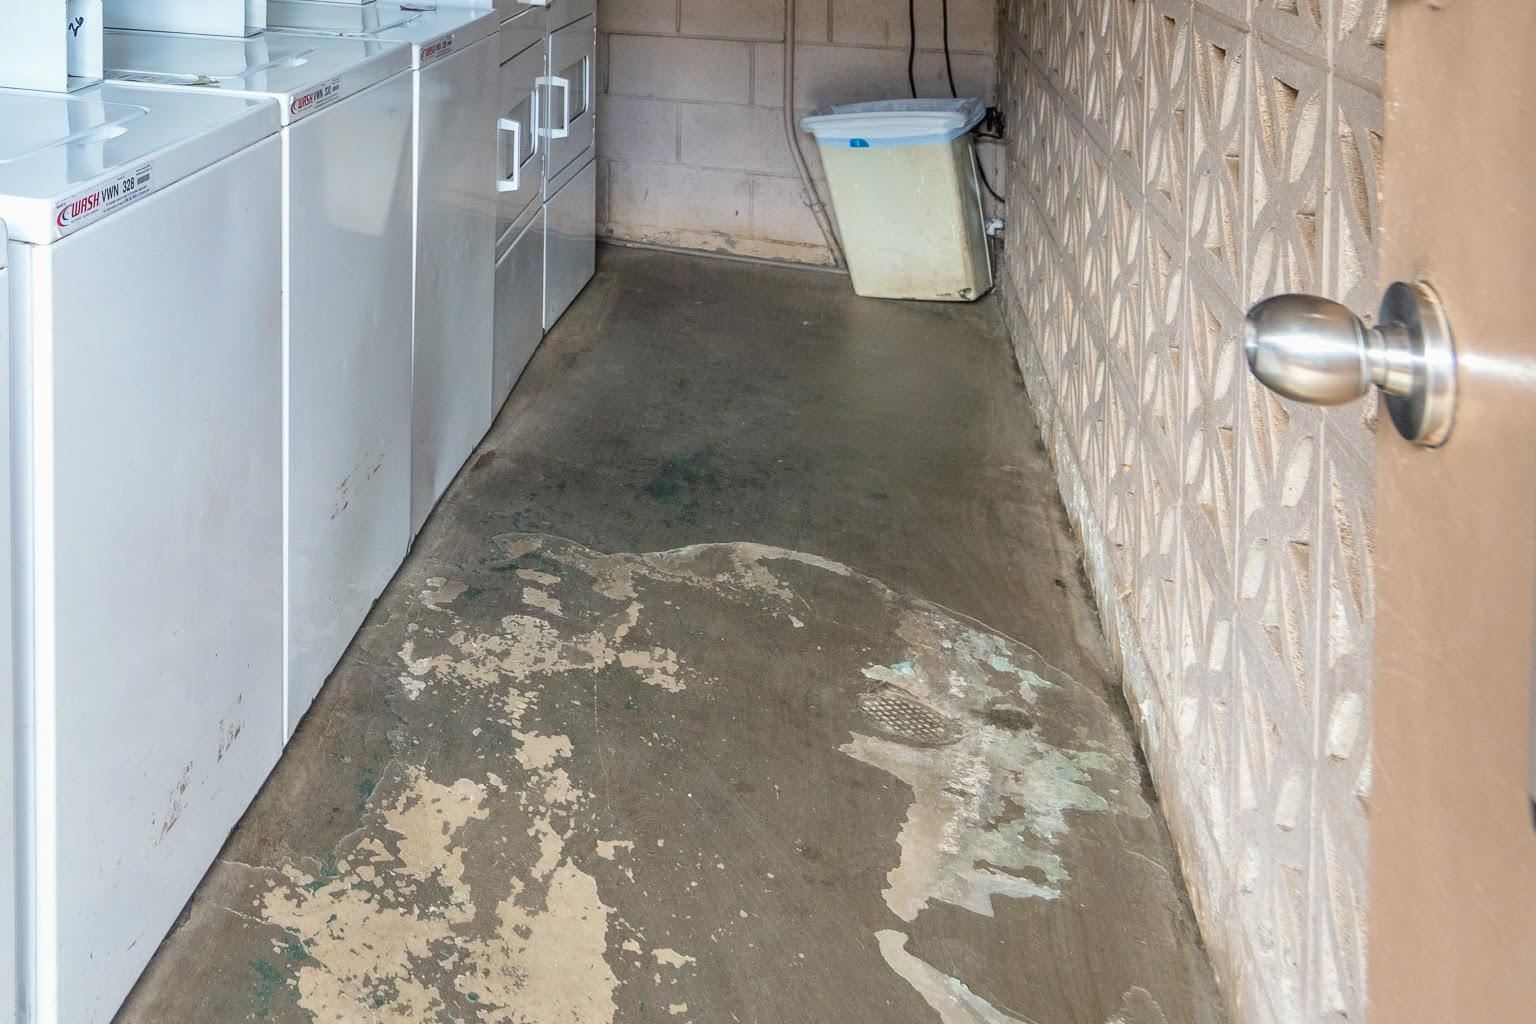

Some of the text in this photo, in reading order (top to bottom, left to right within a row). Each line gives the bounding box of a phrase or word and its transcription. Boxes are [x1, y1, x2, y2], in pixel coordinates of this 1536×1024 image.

[72, 192, 100, 218] WASH
[101, 184, 119, 202] VWN
[122, 177, 134, 193] 328
